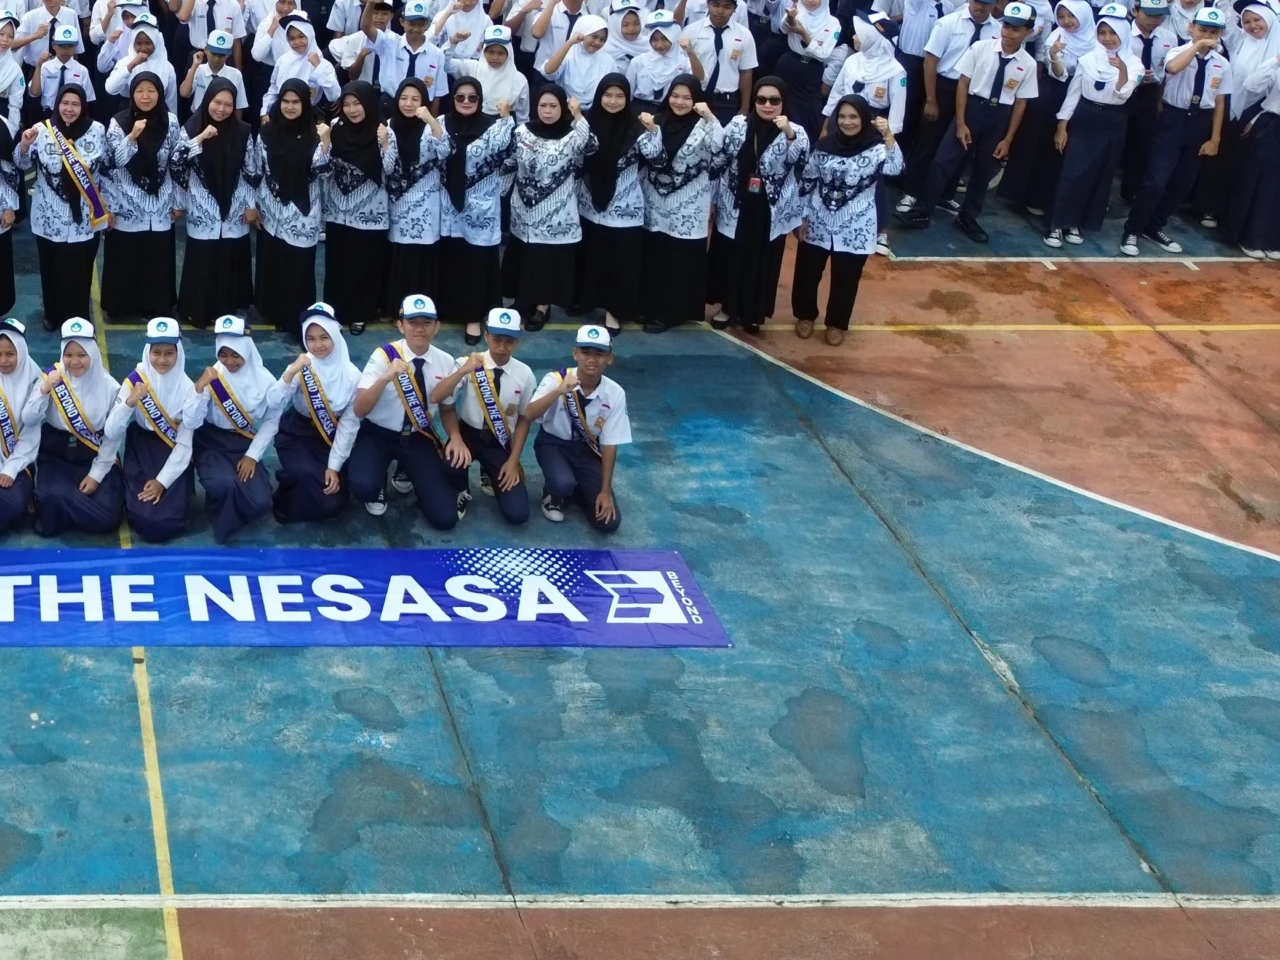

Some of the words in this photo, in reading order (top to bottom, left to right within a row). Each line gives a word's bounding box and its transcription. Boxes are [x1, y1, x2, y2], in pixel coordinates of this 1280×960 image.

[72, 162, 91, 190] NESASA
[54, 384, 78, 418] BEYOND
[71, 415, 87, 433] THE
[310, 391, 325, 410] THE
[405, 389, 420, 408] THE
[475, 371, 494, 403] BEYOND
[487, 400, 502, 420] THE
[1, 418, 15, 438] THE
[155, 415, 170, 434] THE
[222, 398, 248, 429] BEYOND
[316, 407, 336, 437] NESASA
[182, 574, 590, 623] NESASA
[666, 570, 704, 625] BEYOND
